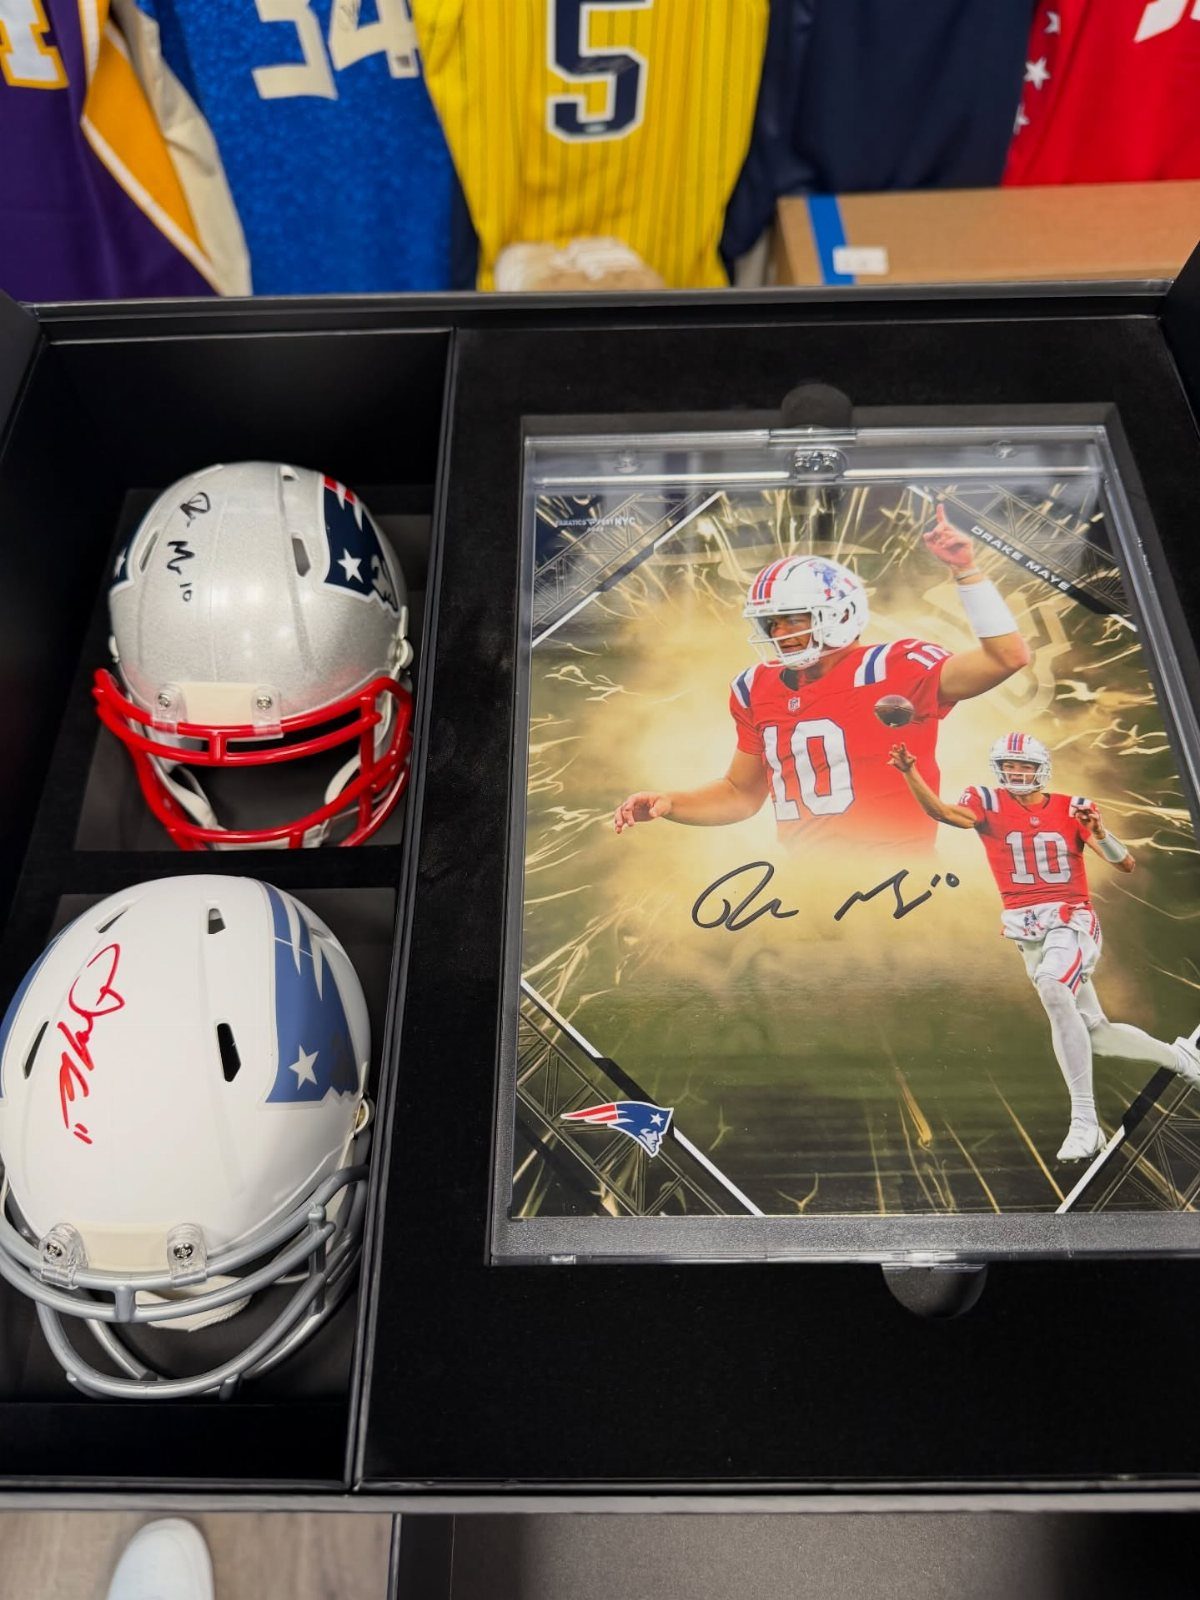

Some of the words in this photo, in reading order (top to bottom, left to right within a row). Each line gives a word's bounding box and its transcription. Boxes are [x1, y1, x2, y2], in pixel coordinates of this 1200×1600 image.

[546, 0, 653, 143] 5
[970, 525, 1024, 561] DRAKE
[1024, 560, 1073, 591] MAYE
[762, 717, 856, 821] 10
[1005, 831, 1072, 884] 10
